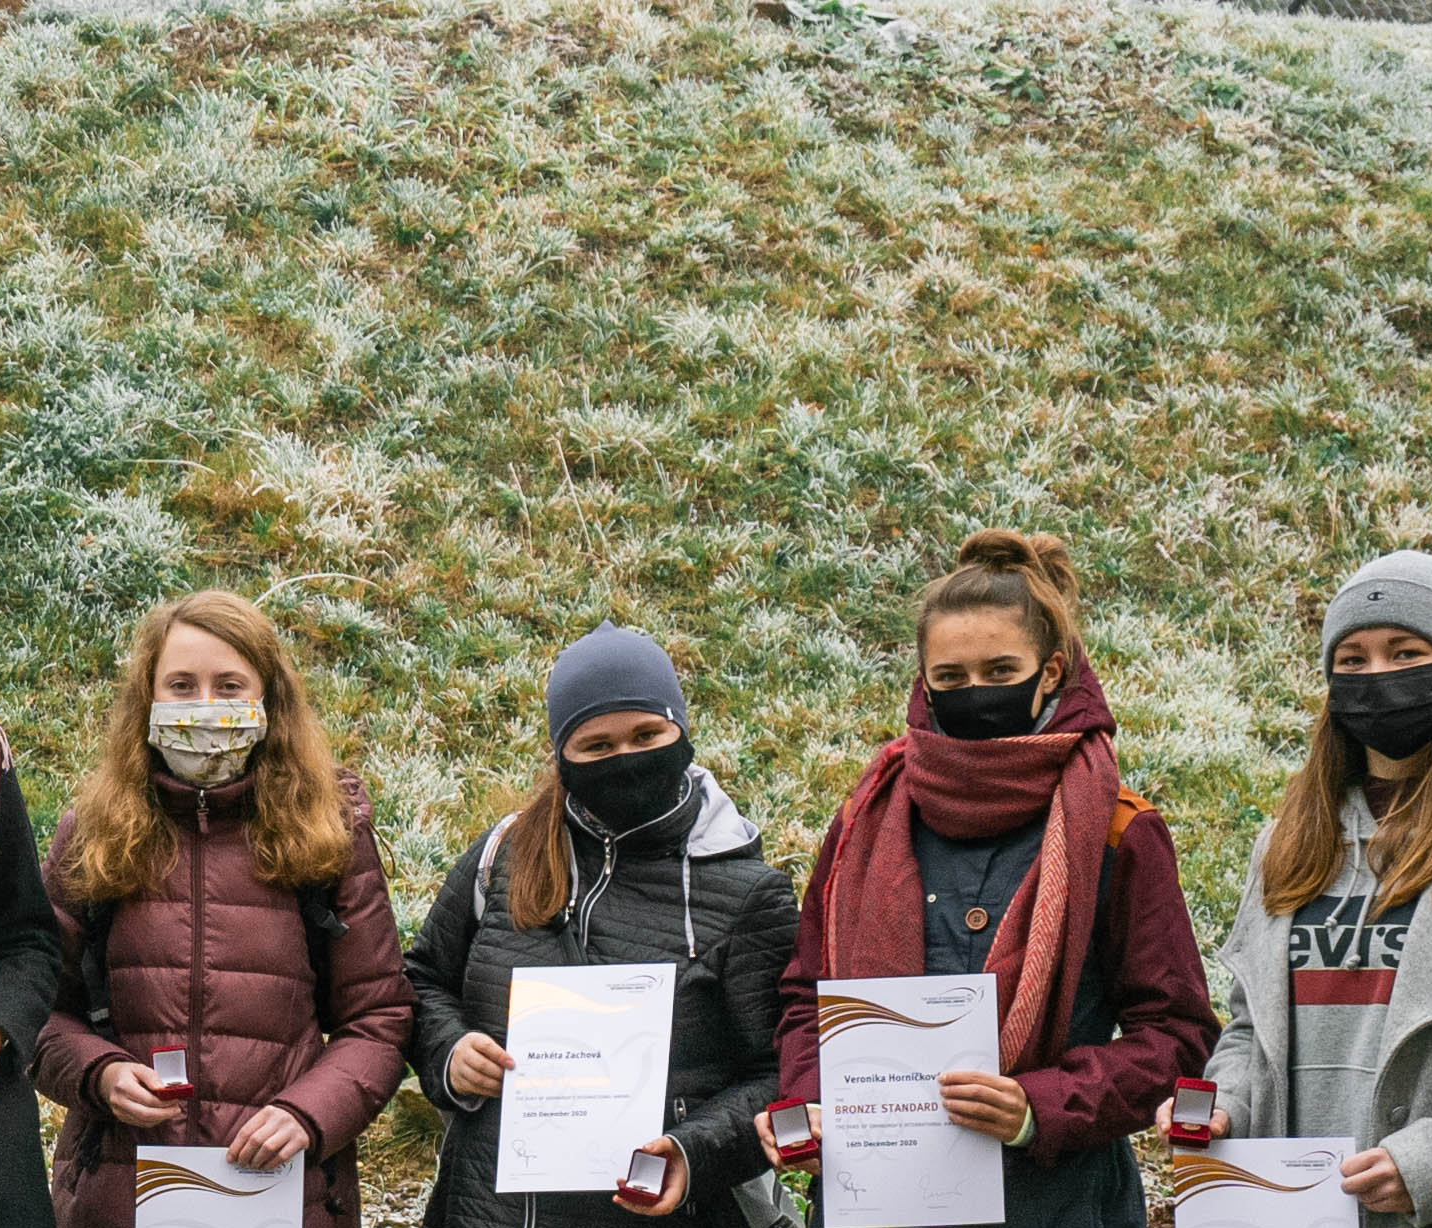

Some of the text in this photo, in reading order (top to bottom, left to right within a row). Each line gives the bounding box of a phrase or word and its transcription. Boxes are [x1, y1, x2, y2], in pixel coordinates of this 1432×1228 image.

[1290, 926, 1409, 969] evi's
[844, 1074, 886, 1084] Veronika
[835, 1102, 938, 1114] BRONZE STANDARD
